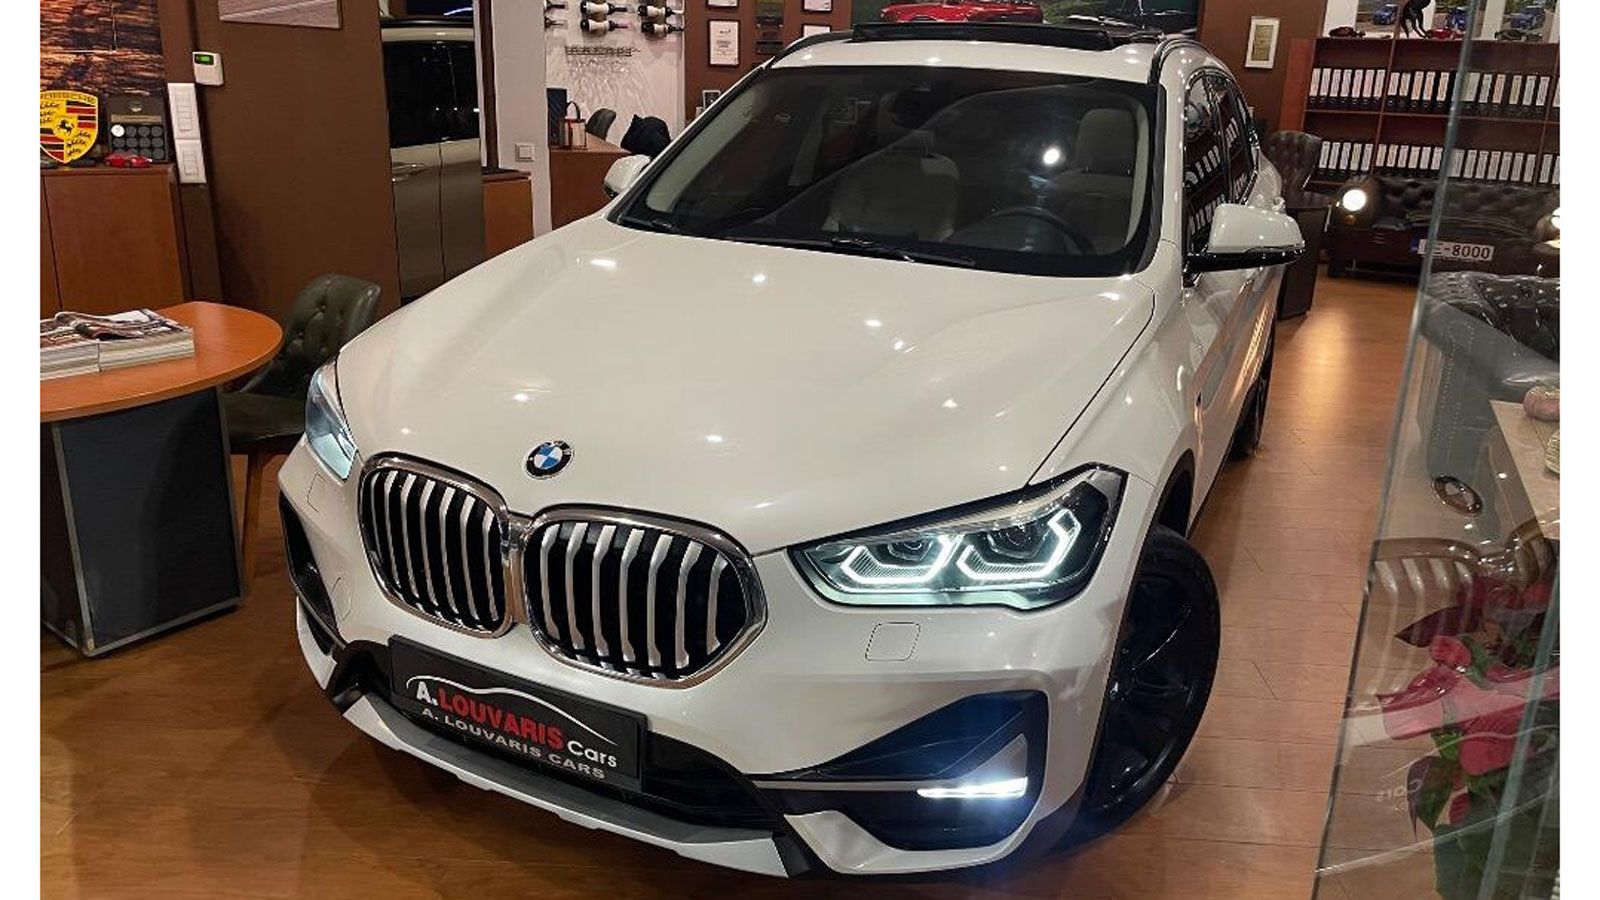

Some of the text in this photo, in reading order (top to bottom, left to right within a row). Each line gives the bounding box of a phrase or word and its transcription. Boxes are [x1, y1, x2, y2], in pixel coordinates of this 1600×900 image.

[445, 715, 541, 757] LOUVARIS
[549, 753, 605, 779] CARS
[567, 741, 617, 767] Cars
